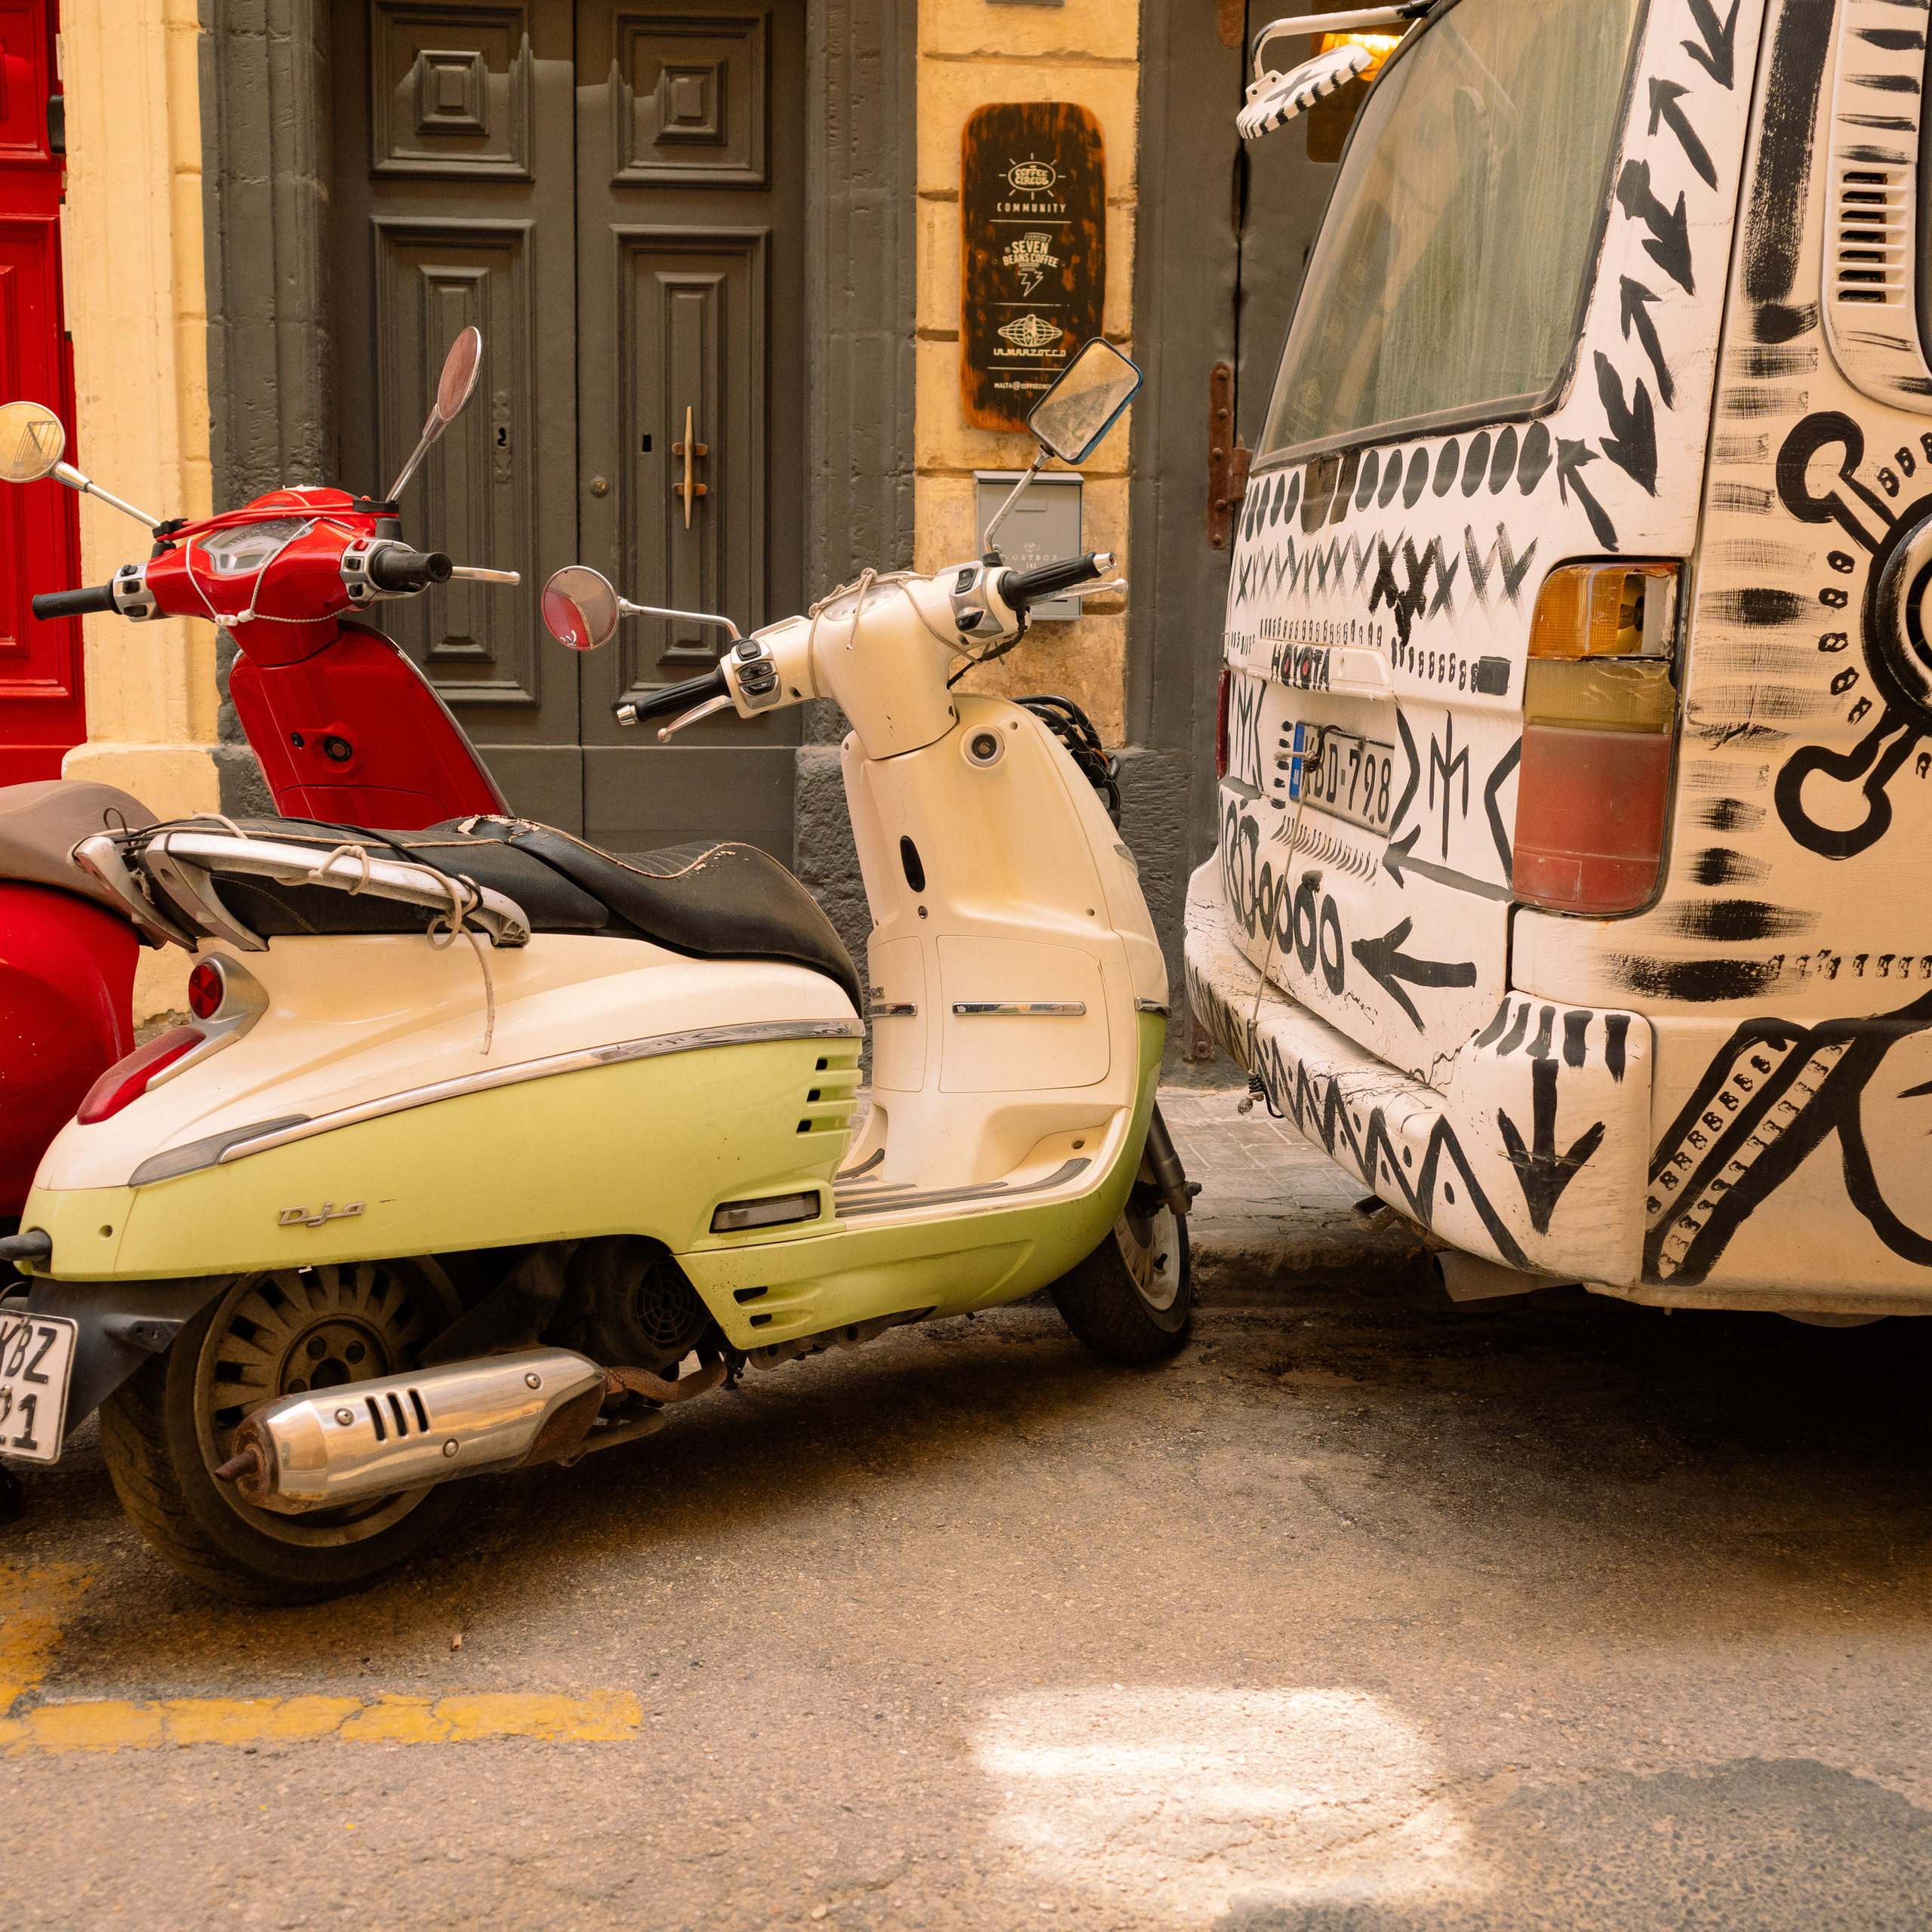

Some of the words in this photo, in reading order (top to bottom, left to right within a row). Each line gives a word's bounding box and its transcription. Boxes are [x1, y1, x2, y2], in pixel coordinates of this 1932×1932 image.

[1015, 168, 1048, 177] COFFEE
[997, 202, 1066, 213] COMMUNITY
[1011, 240, 1048, 254] SEVEN
[1002, 253, 1029, 266] BEANS
[1030, 253, 1060, 268] COFFEE
